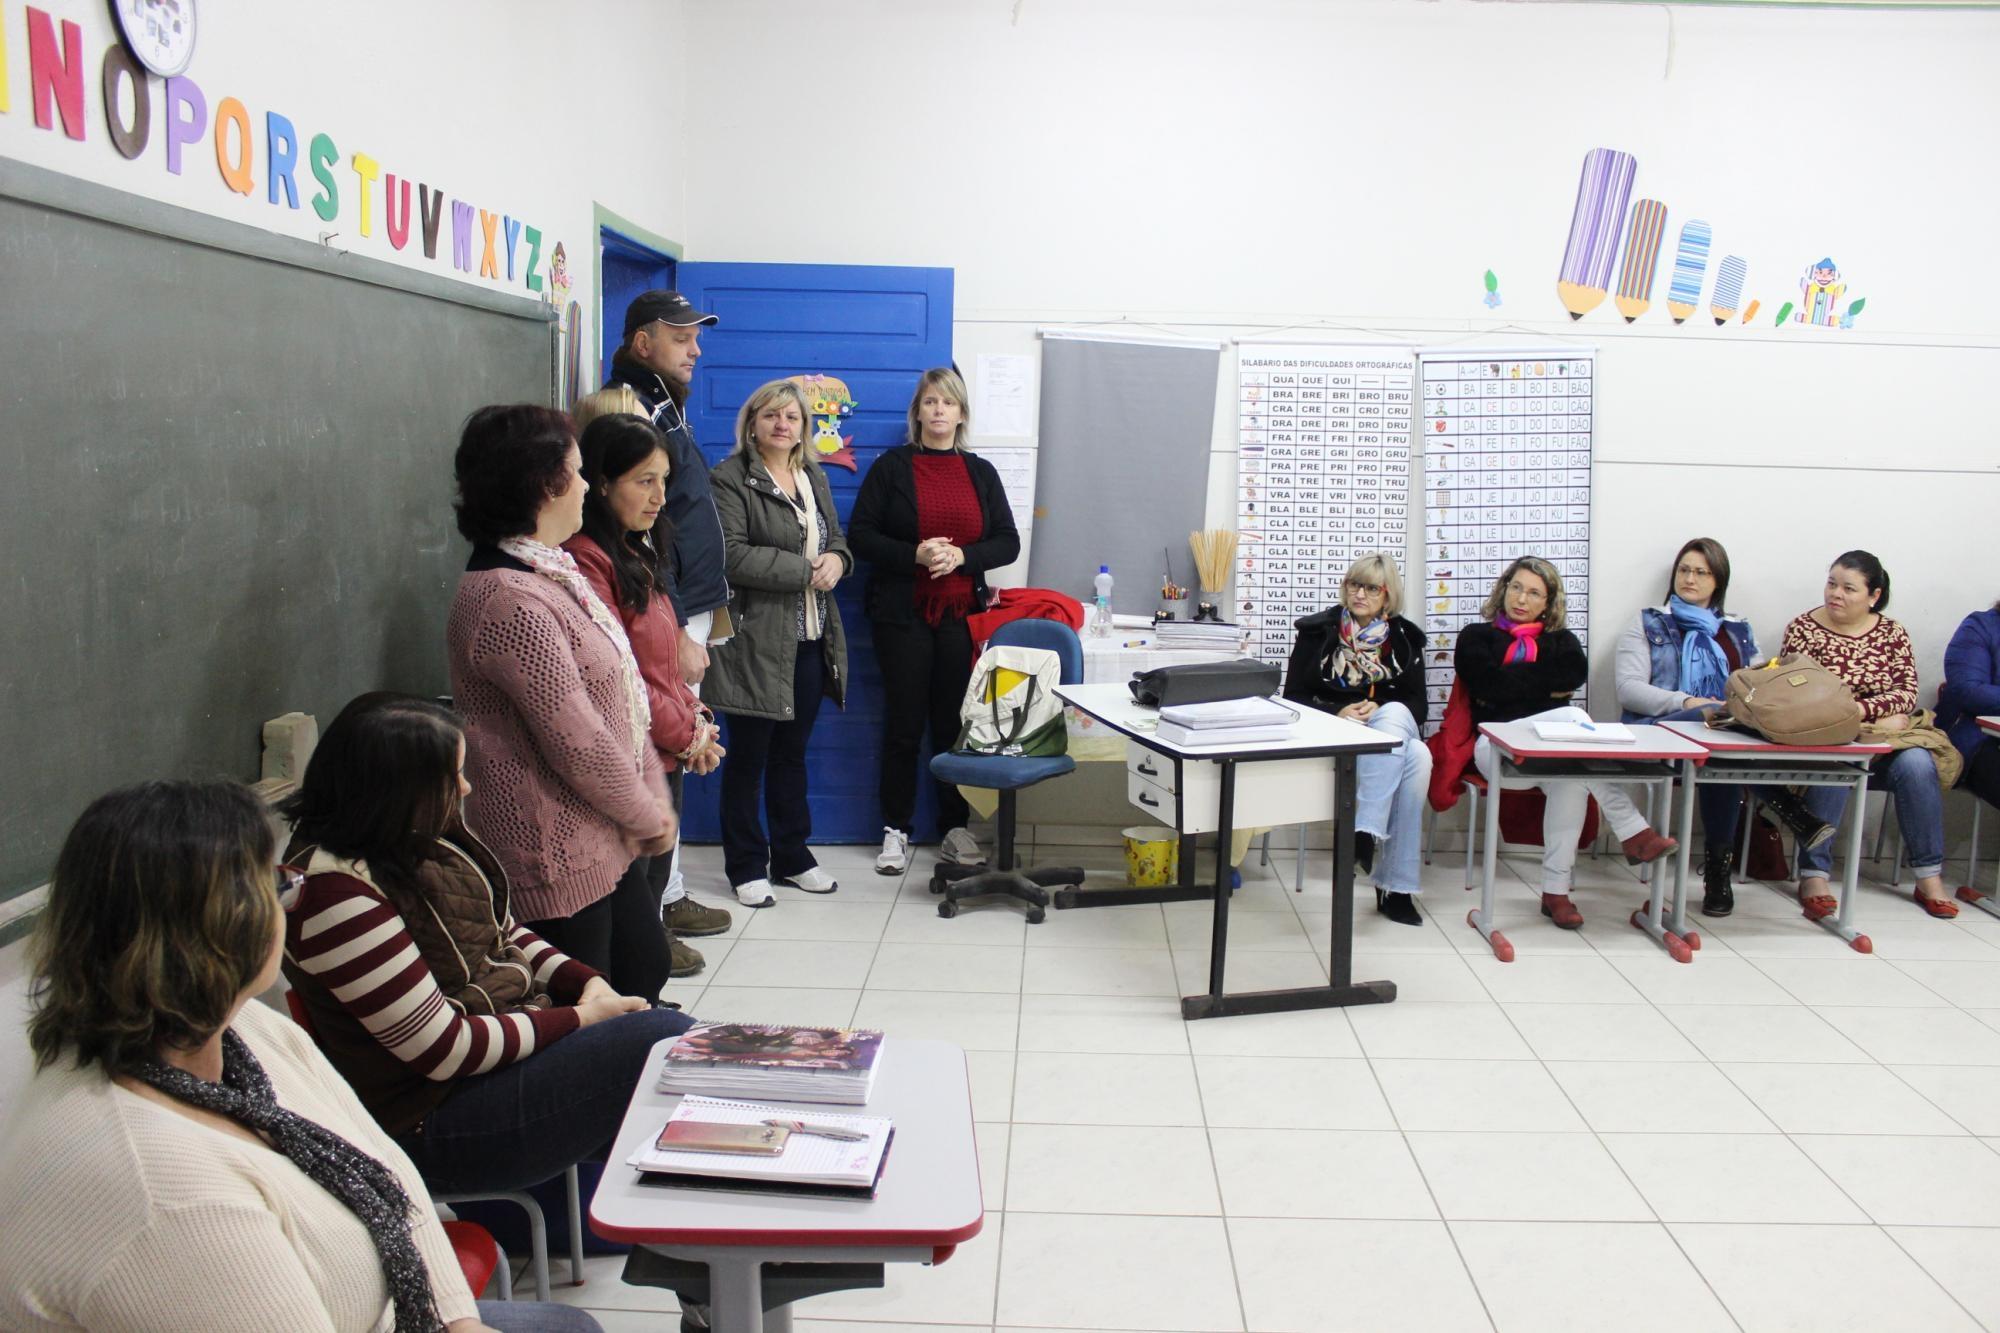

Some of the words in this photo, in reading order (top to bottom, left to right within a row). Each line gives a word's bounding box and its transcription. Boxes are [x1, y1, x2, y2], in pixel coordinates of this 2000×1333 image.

[27, 5, 86, 141] N
[104, 44, 150, 160] O
[165, 75, 207, 175] P
[215, 97, 254, 196] Q
[267, 111, 299, 209] R
[310, 133, 339, 222] S
[352, 152, 379, 237] T
[386, 174, 410, 251] U
[419, 182, 444, 259] V
[452, 199, 475, 272] W
[480, 209, 498, 279] X
[504, 215, 521, 281] Y
[526, 225, 542, 292] Z
[1300, 360, 1353, 368] DIFICULDADES
[1302, 376, 1323, 384] QUE
[1332, 377, 1351, 385] QUI
[1302, 391, 1322, 399] BRE
[1359, 392, 1380, 400] BRO
[1388, 393, 1409, 401] BRU
[1272, 405, 1293, 413] CRA
[1332, 406, 1349, 414] CRI
[1387, 407, 1408, 415] CRU
[1272, 419, 1293, 427] DRA
[1301, 420, 1321, 428] DRE
[1358, 421, 1379, 429] DRO
[1301, 434, 1320, 442] FRE
[1358, 435, 1378, 443] FRO
[1387, 436, 1407, 444] FRU
[1271, 448, 1292, 456] GRA
[1330, 449, 1348, 457] GRI
[1356, 450, 1378, 458] GRO
[1385, 450, 1407, 458] GRU
[1271, 462, 1291, 470] PRA
[1300, 463, 1319, 471] PRE
[1357, 464, 1377, 472] PRO
[1300, 477, 1319, 485] TRE
[1356, 478, 1377, 486] TRO
[1385, 479, 1406, 487] TRU
[1329, 492, 1346, 500] VRI
[1384, 493, 1405, 501] VRU
[1270, 505, 1290, 513] BLA
[1299, 506, 1318, 514] BLE
[1329, 506, 1345, 514] BLI
[1355, 507, 1376, 515] BLO
[1384, 507, 1404, 515] BLU
[1298, 520, 1317, 528] CLE
[1355, 521, 1375, 529] CLO
[1383, 522, 1404, 530] CLU
[1299, 534, 1316, 542] FLE
[1383, 536, 1402, 544] FLU
[1297, 548, 1317, 556] GLE
[1327, 549, 1344, 557] GLI
[1268, 562, 1288, 570] PLA
[1327, 563, 1343, 571] PLI
[1268, 576, 1287, 584] TLA
[1296, 591, 1315, 599] VLE
[1295, 605, 1315, 613] CHE
